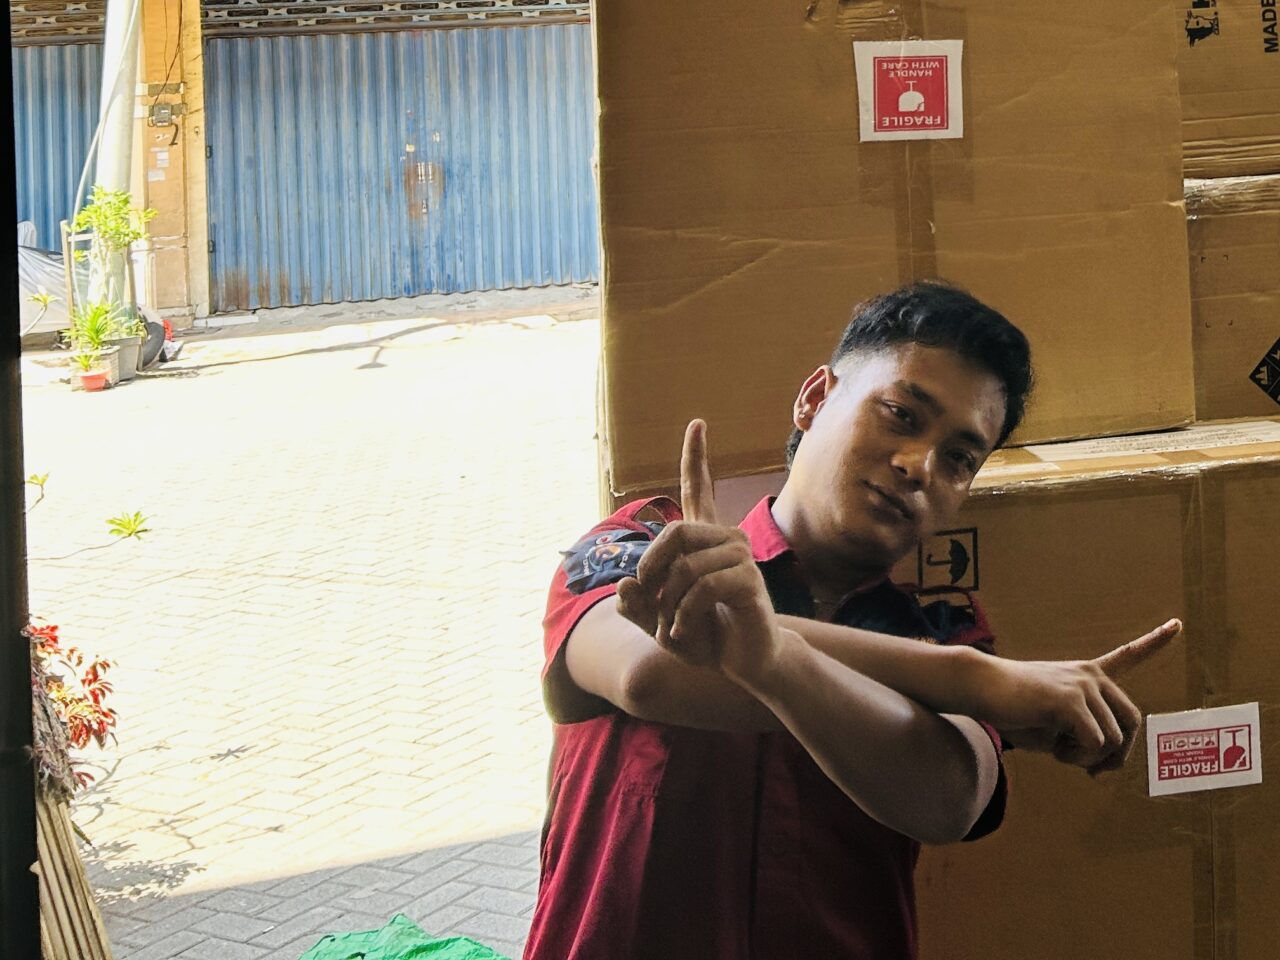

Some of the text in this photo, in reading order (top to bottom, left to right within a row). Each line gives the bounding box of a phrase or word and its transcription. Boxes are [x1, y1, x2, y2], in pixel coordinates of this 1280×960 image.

[881, 61, 940, 70] WITH CARE
[889, 70, 933, 78] HANDLE
[882, 115, 941, 127] FRAGILE
[1160, 760, 1219, 778] FRAGILE
